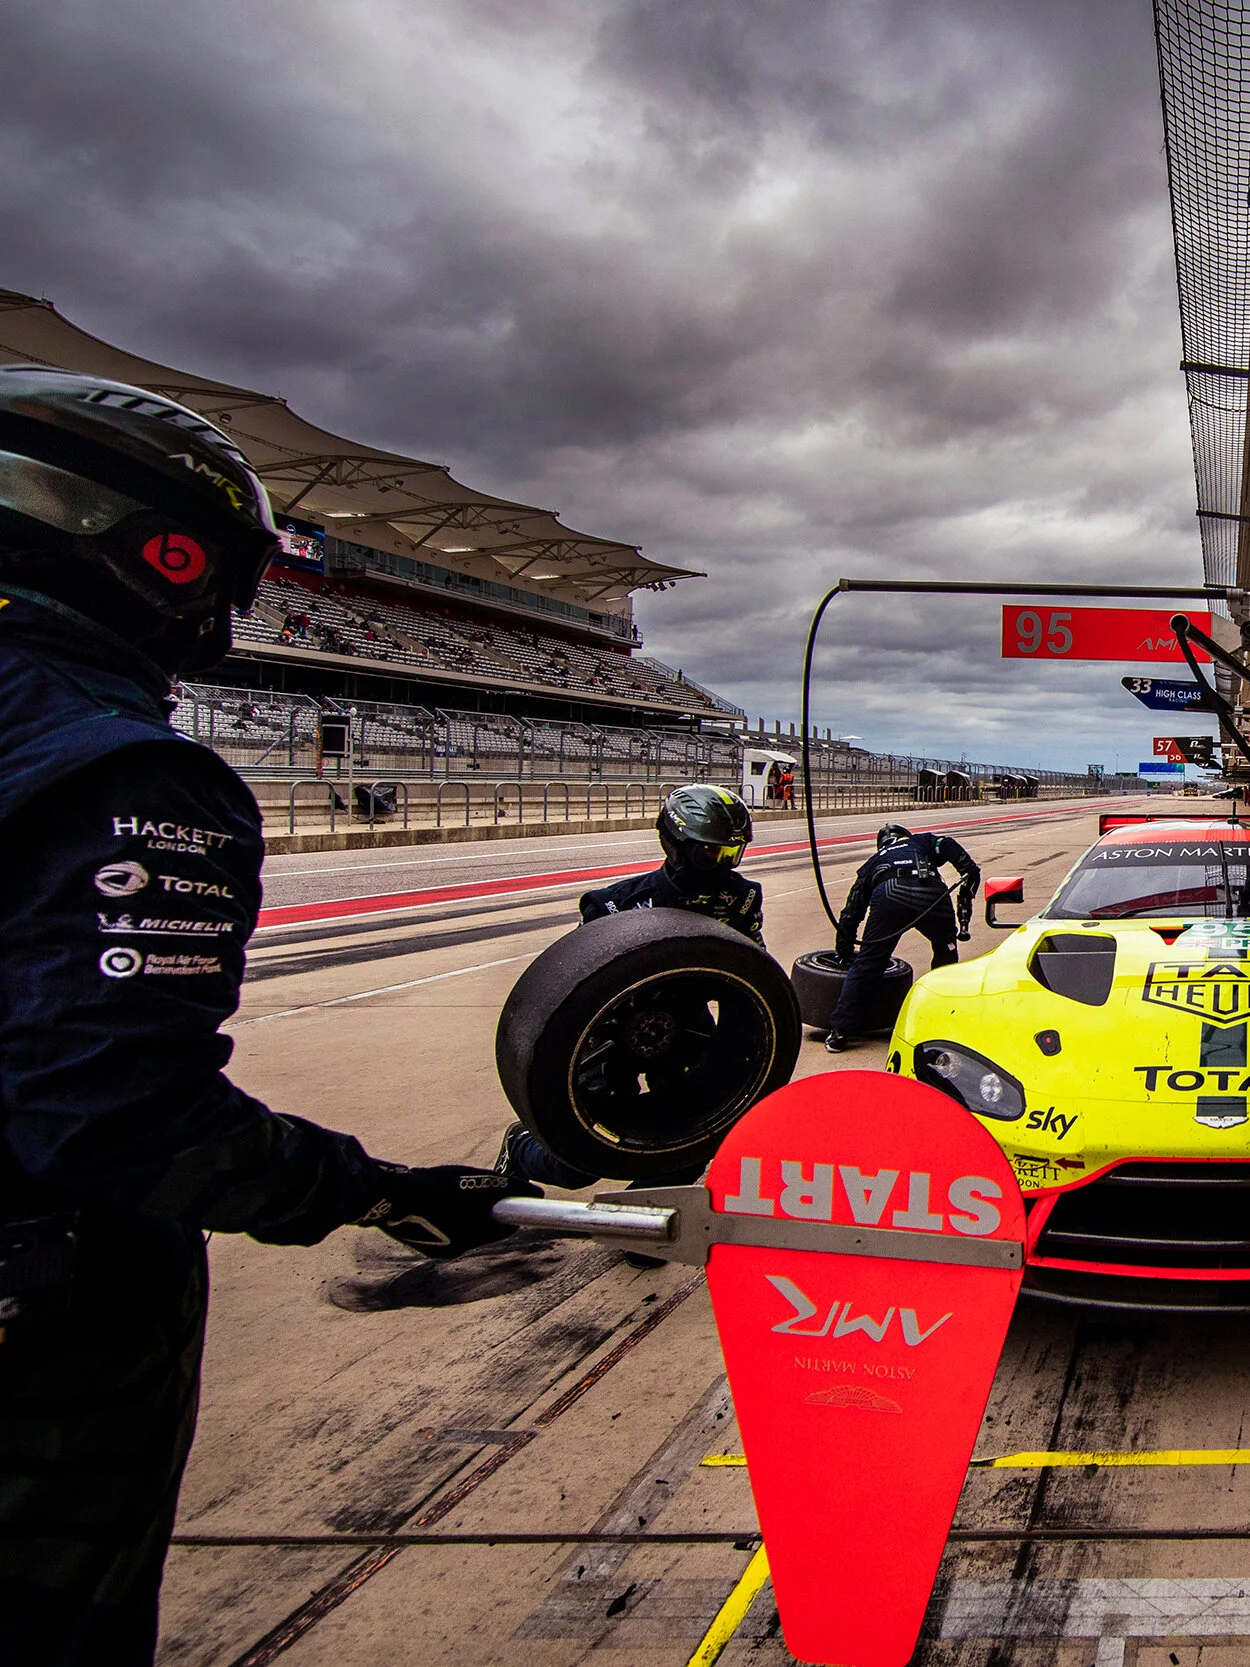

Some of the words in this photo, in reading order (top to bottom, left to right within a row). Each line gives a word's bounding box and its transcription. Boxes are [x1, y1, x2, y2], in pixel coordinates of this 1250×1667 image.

[167, 453, 243, 511] AMR
[1015, 610, 1074, 655] 95
[1130, 678, 1152, 694] 33
[1155, 689, 1176, 698] HIGH
[1177, 690, 1201, 700] CLASS
[1156, 740, 1173, 752] 57
[112, 816, 234, 849] HACKETT
[147, 839, 208, 856] LONDON
[1091, 848, 1174, 861] ASTON
[157, 875, 235, 899] TOTAL
[139, 918, 234, 933] MICHELIN
[1025, 1106, 1079, 1141] sky
[724, 1156, 1003, 1236] START
[763, 1274, 954, 1347] AMR
[794, 1356, 857, 1373] MARTIN
[862, 1363, 916, 1381] ASTON
